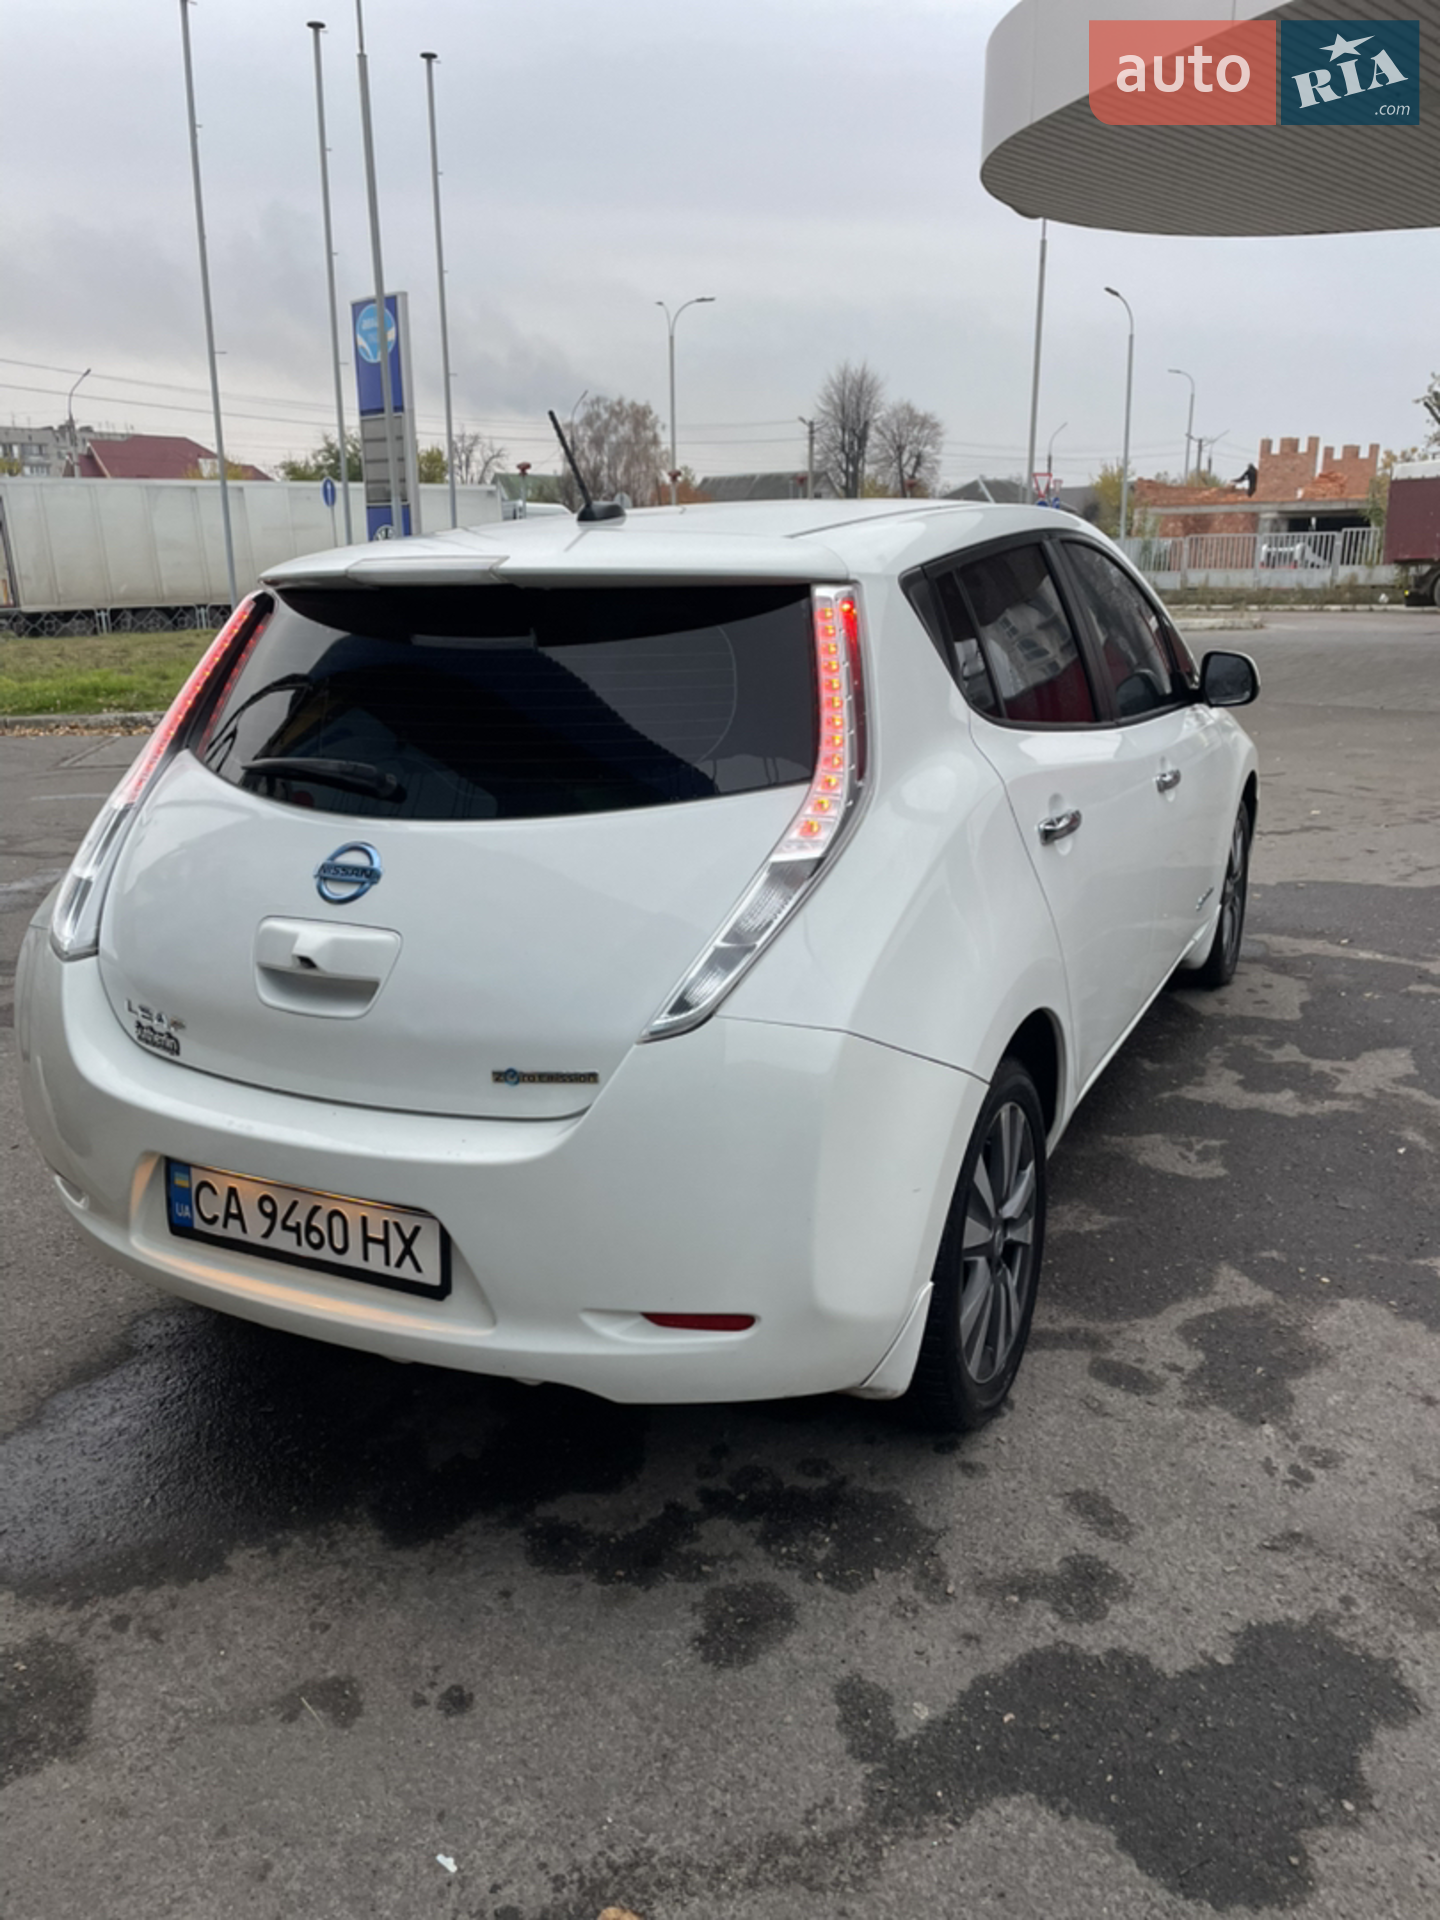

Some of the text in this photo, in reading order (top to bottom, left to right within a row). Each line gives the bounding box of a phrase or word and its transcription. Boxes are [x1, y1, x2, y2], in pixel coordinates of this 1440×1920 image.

[321, 864, 374, 879] NISSAN
[175, 1202, 191, 1219] UA
[195, 1180, 423, 1274] CA 9460 HX
